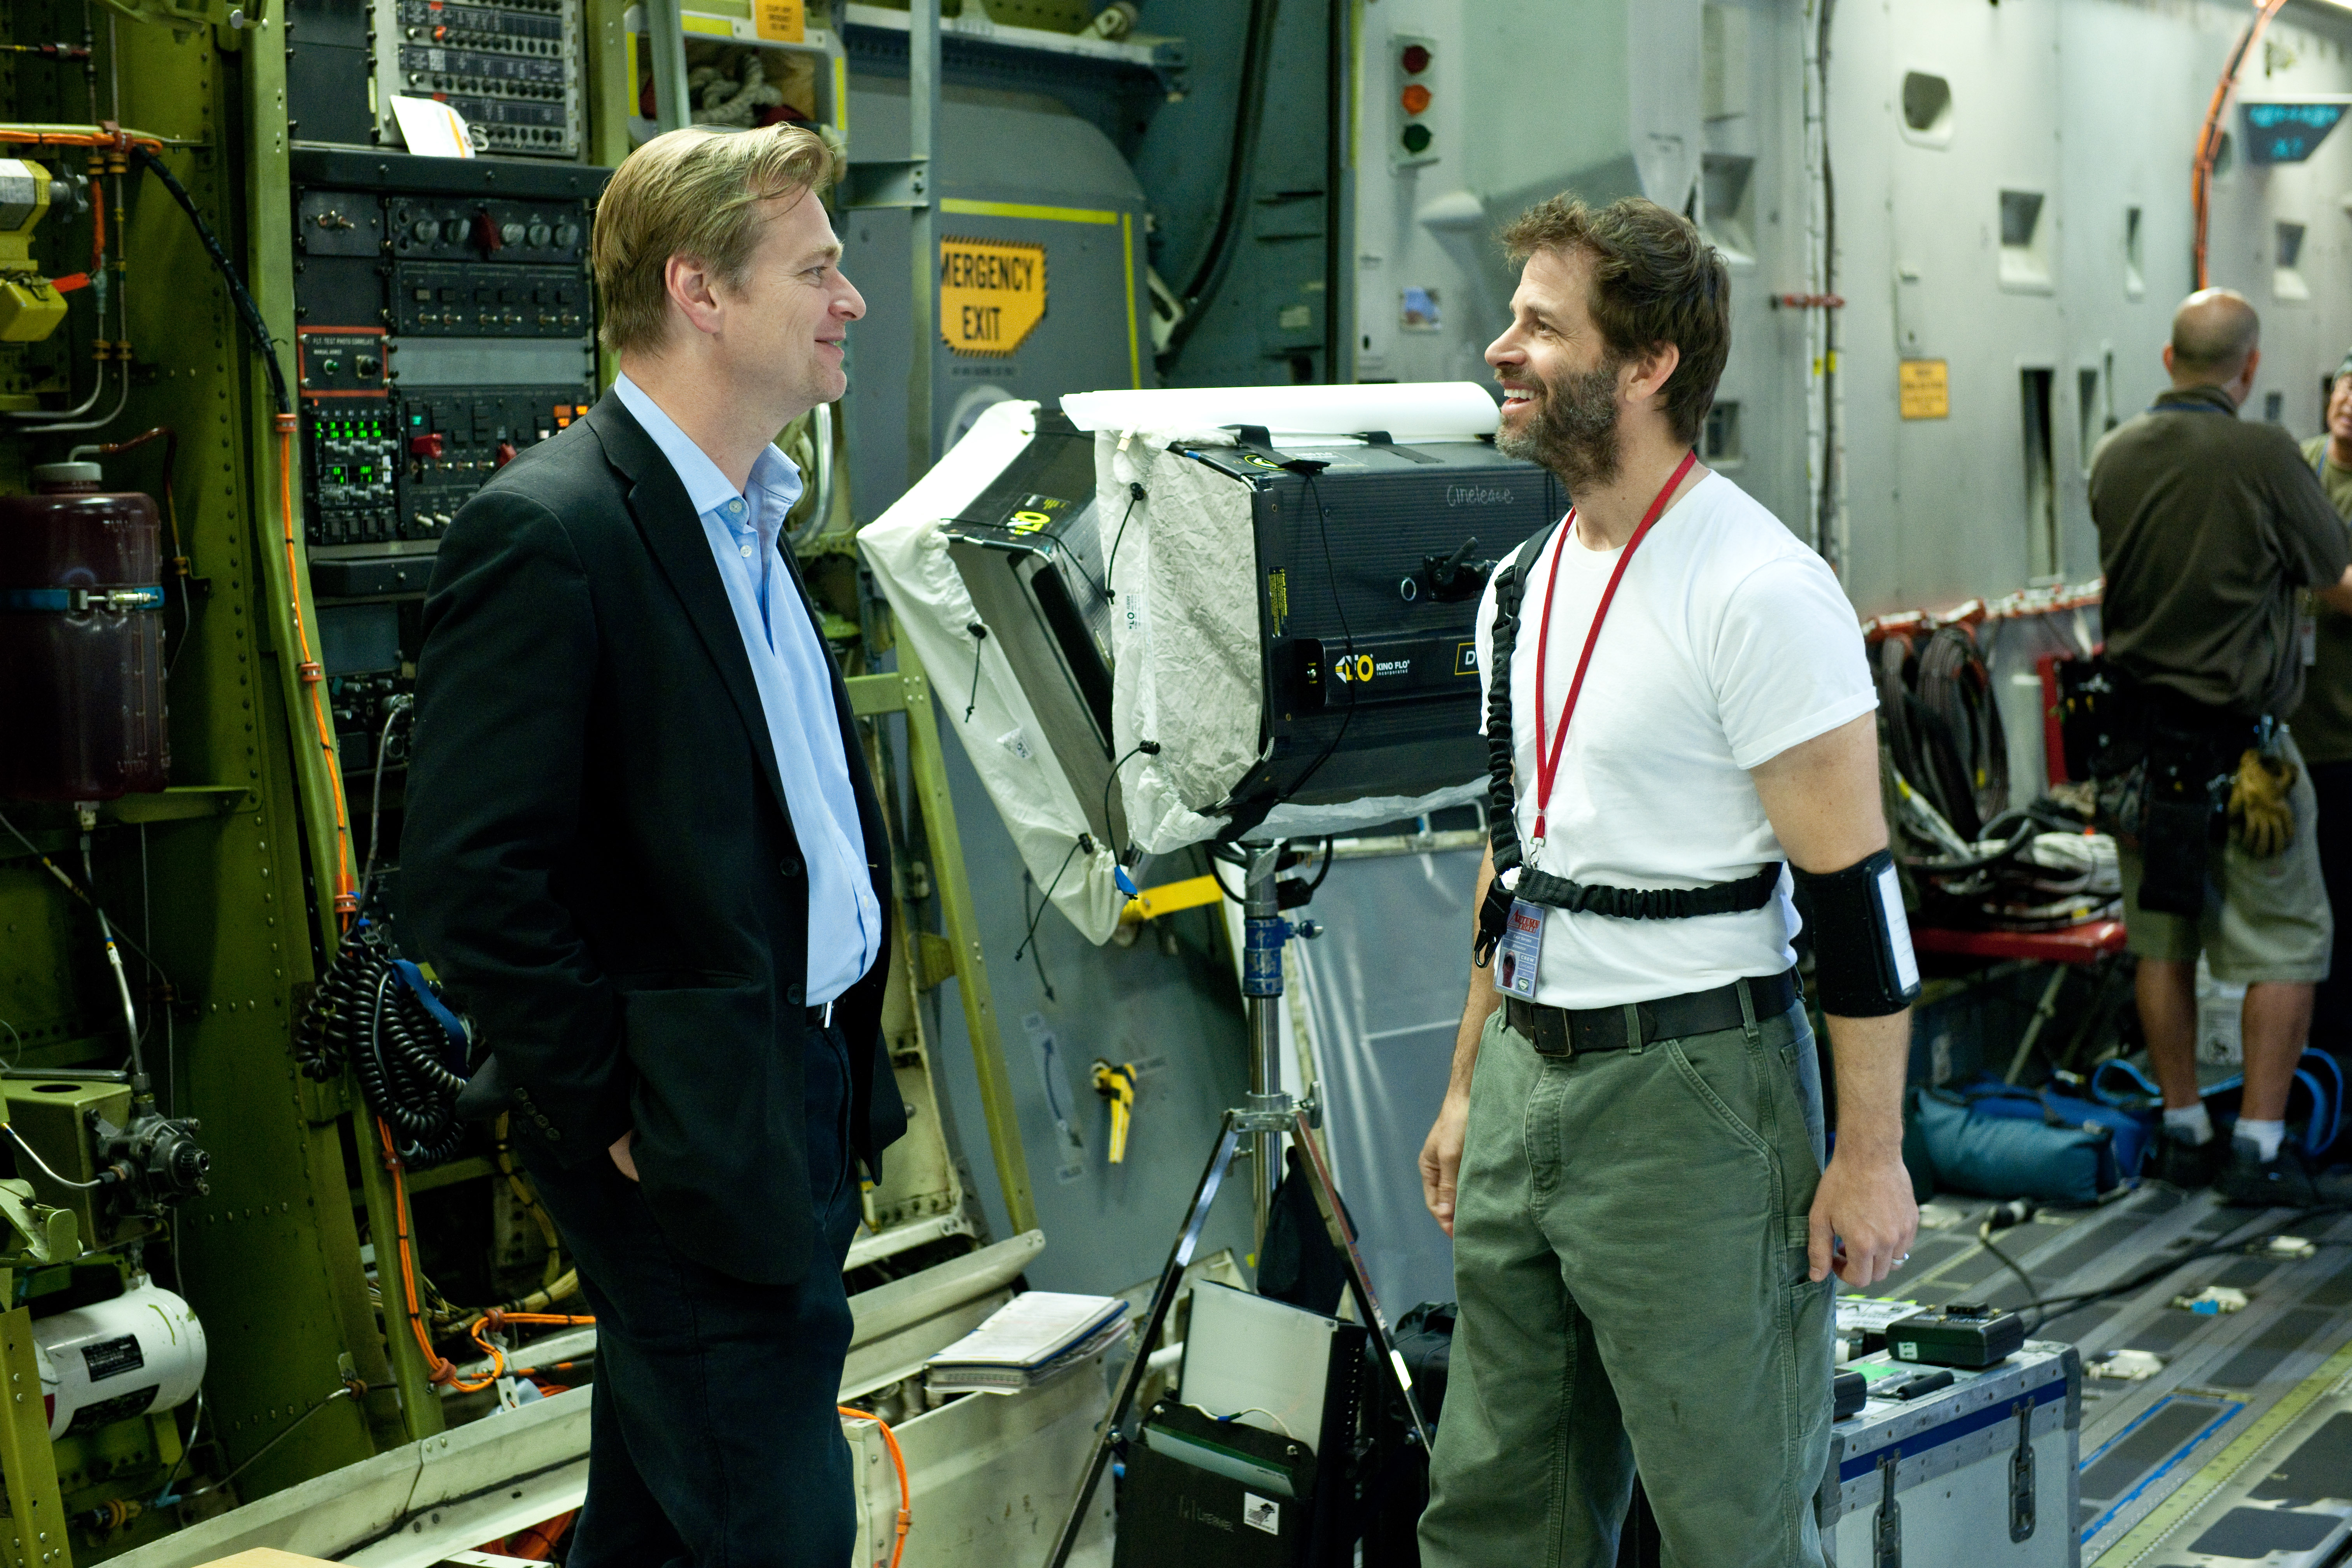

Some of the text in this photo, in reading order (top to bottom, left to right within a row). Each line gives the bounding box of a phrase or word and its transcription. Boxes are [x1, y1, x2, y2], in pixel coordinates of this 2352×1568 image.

[941, 252, 1034, 291] MERGENCY
[963, 306, 1000, 341] EXIT
[1376, 662, 1393, 671] KINO
